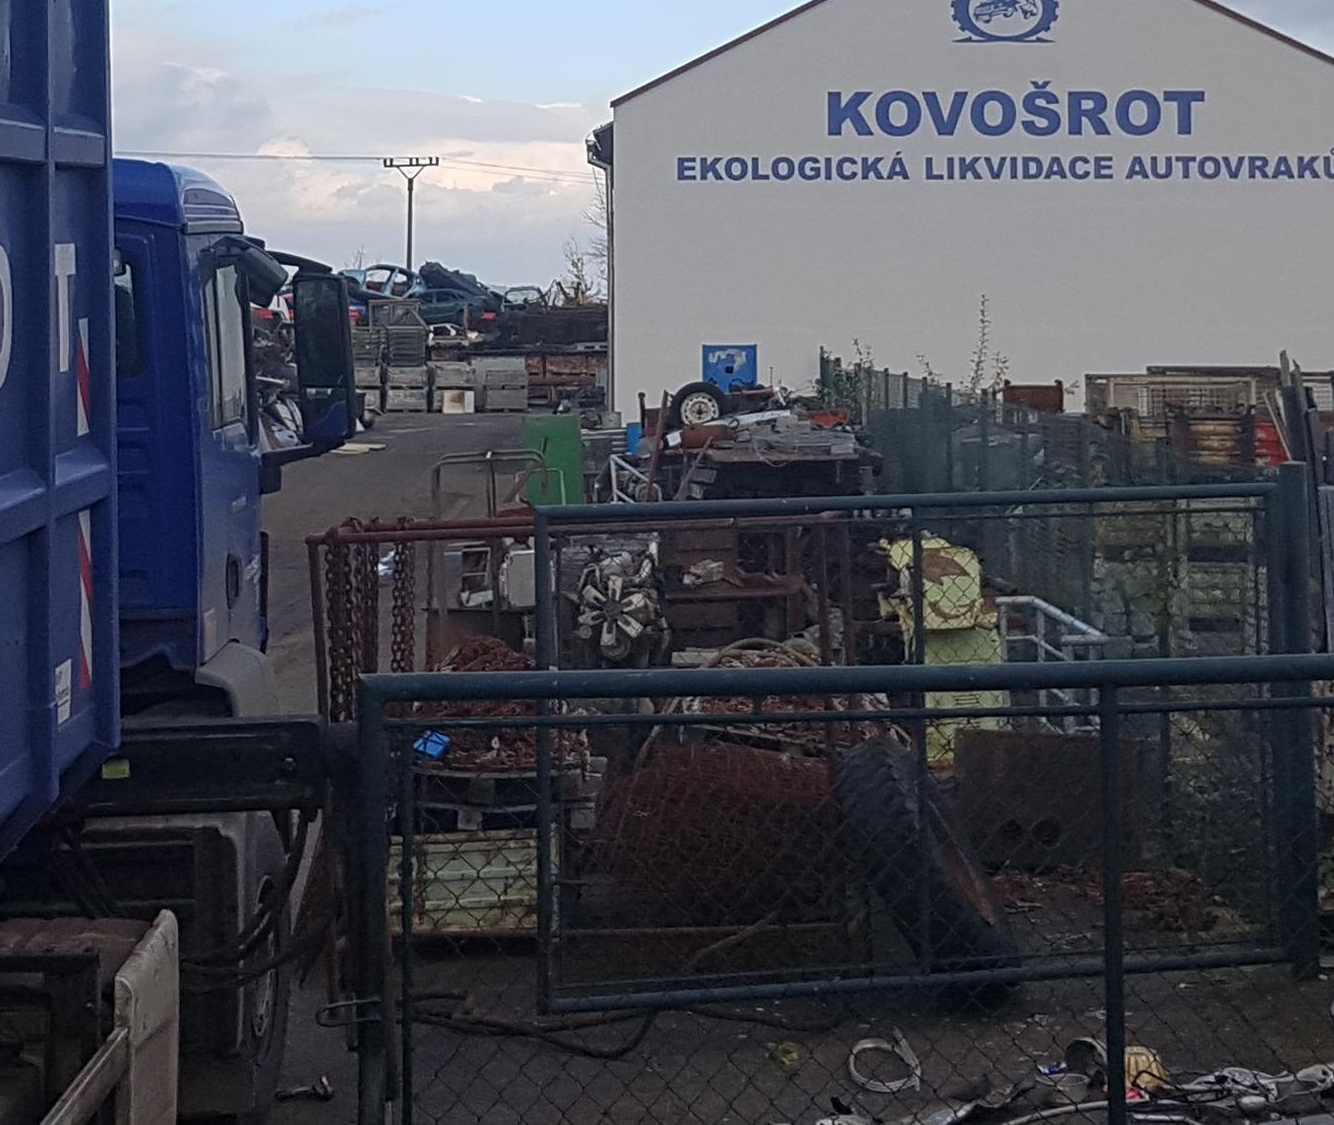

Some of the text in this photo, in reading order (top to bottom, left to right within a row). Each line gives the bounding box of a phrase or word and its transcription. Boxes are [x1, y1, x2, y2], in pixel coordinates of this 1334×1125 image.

[826, 81, 1207, 140] KOVOŠROT
[676, 150, 910, 182] EKOLOGICKÁ
[924, 155, 1114, 181] LIKVIDACE
